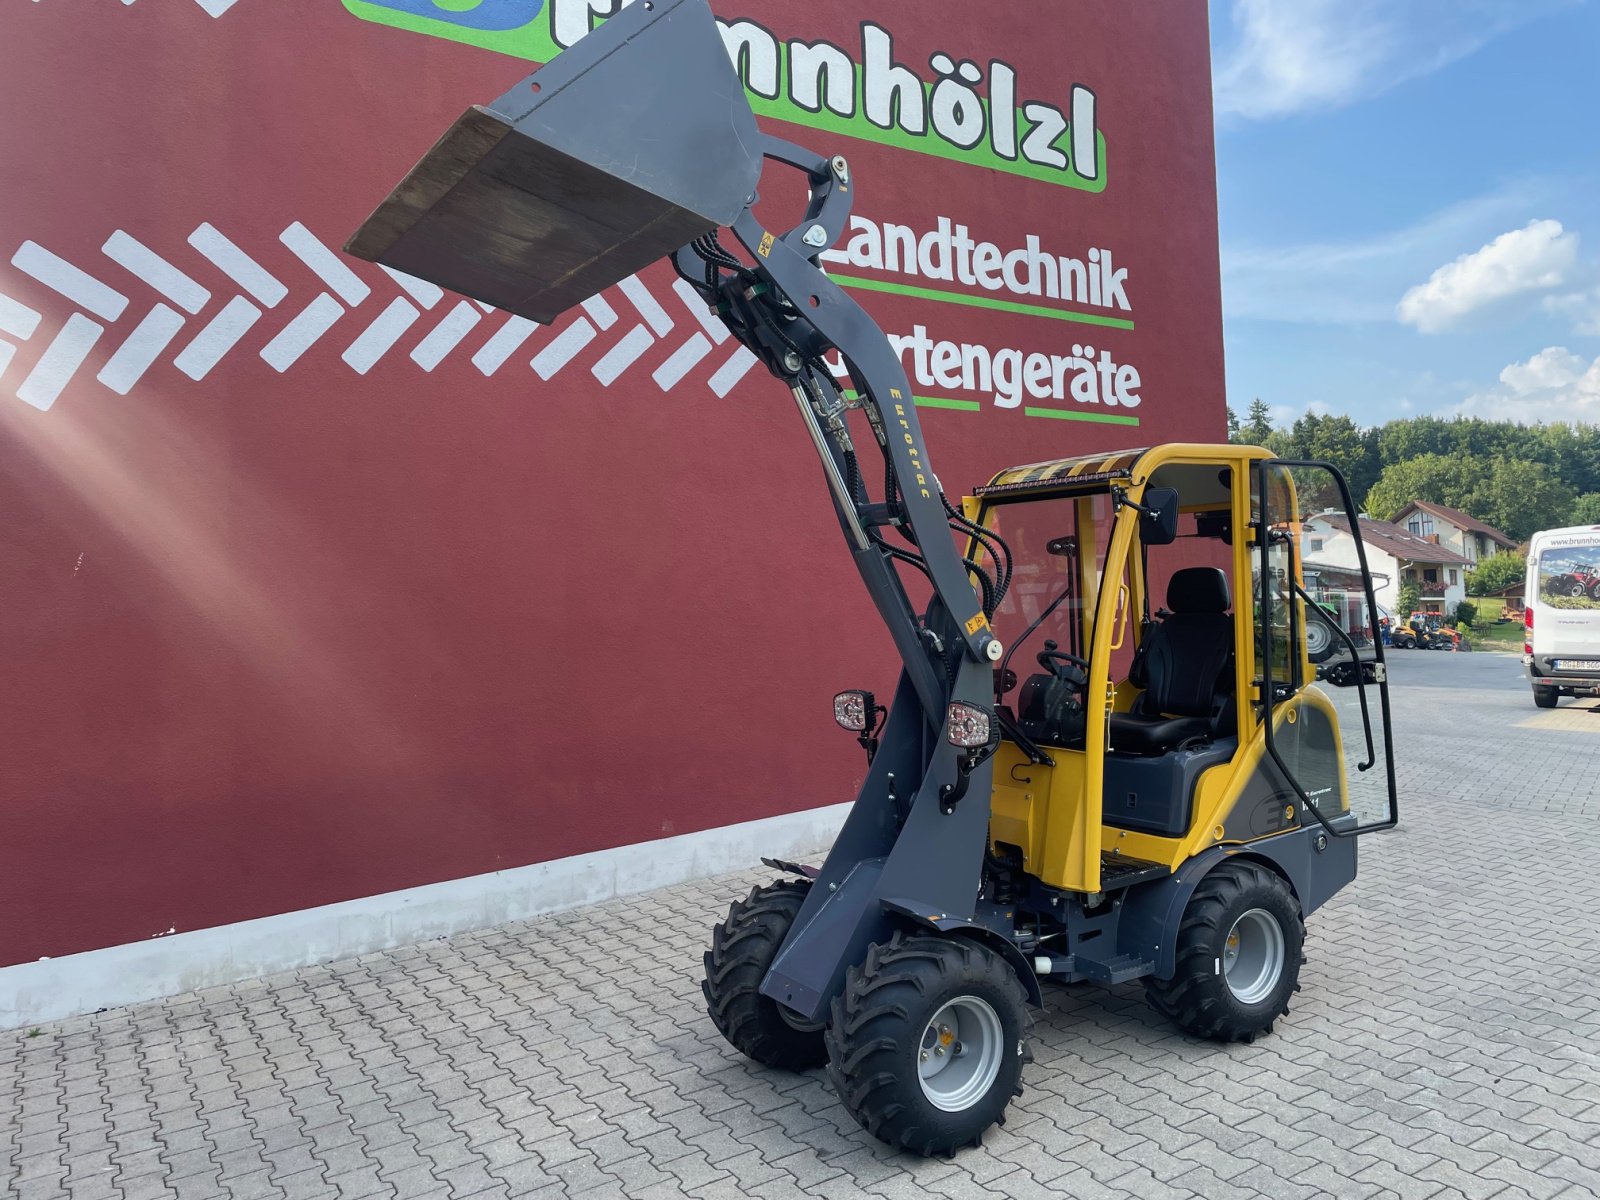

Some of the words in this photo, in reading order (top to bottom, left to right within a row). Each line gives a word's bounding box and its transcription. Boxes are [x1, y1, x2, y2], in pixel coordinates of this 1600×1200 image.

[821, 324, 1142, 409] rtengeräte
[889, 387, 930, 499] Eurotrac
[1551, 536, 1600, 545] www.brunnho
